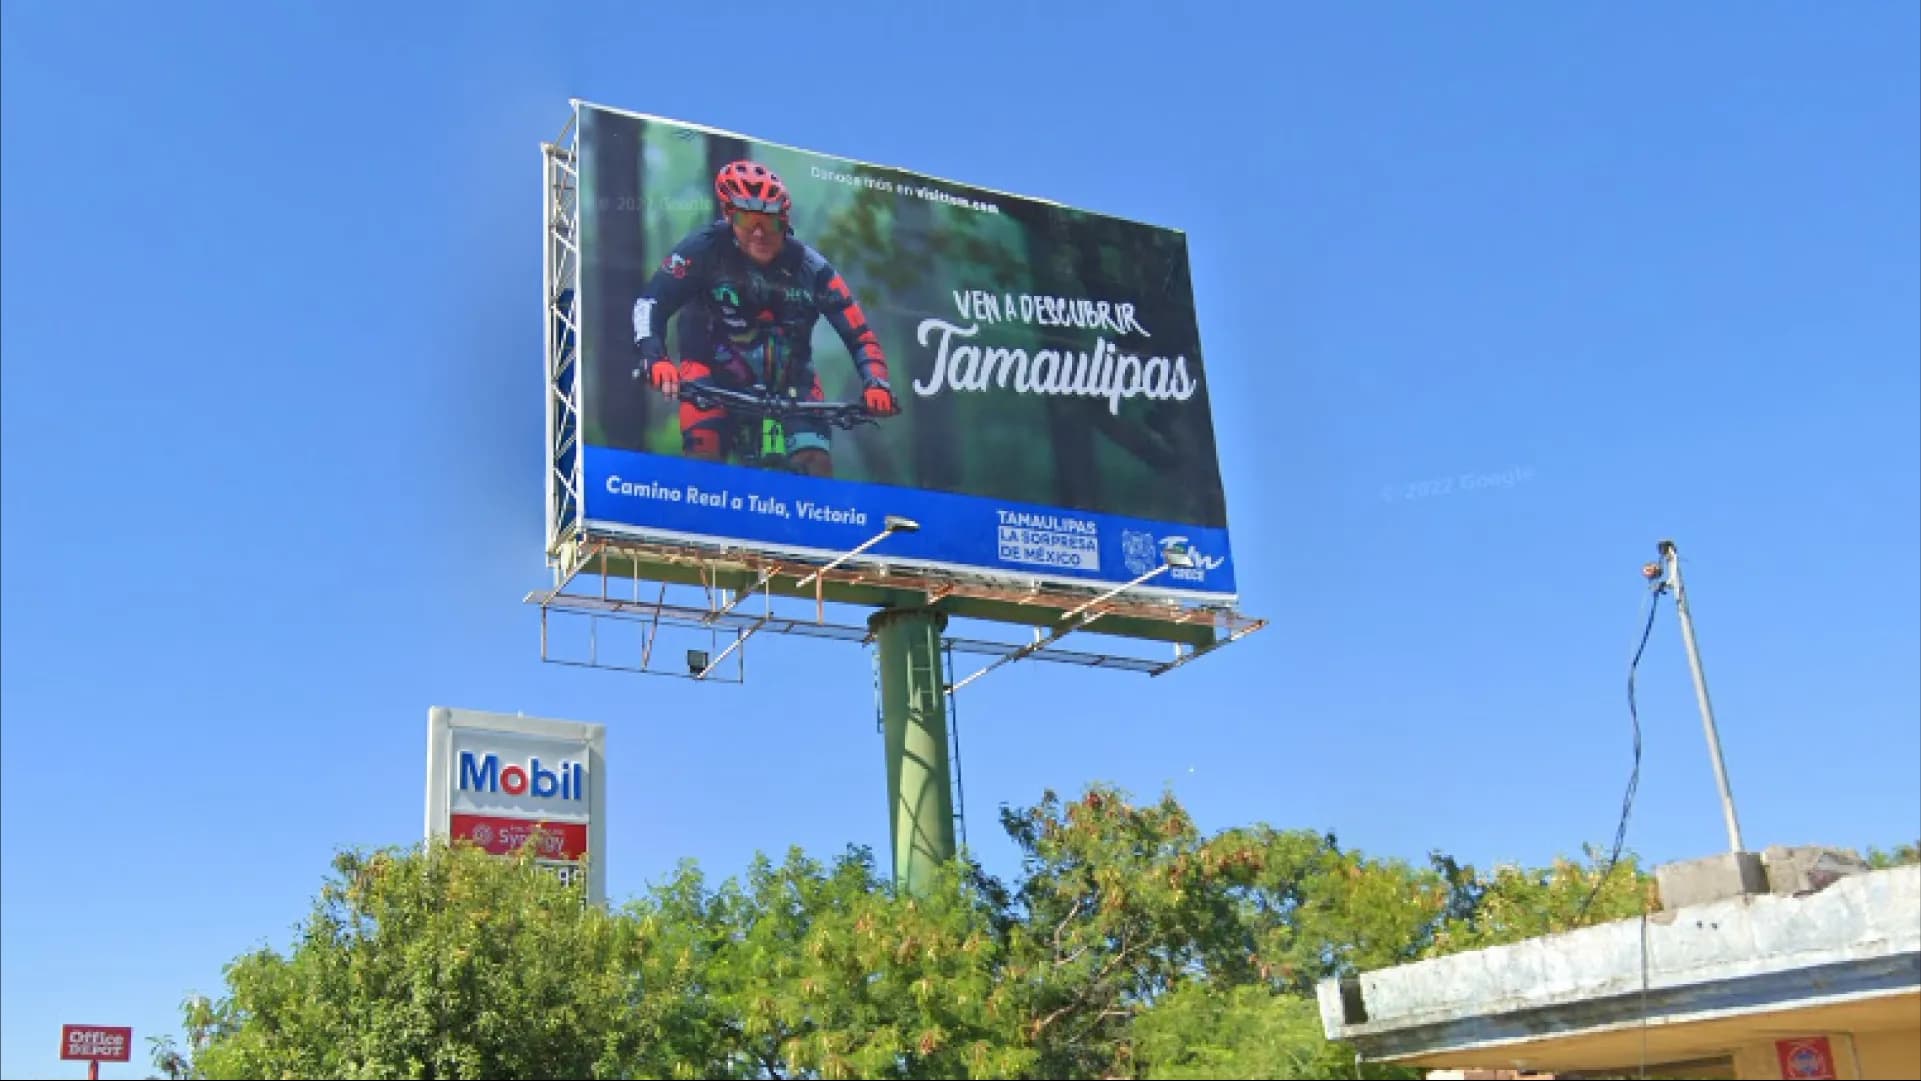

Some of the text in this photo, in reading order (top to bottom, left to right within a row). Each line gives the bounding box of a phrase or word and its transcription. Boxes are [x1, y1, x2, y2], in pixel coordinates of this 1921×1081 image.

[896, 184, 914, 196] en
[952, 289, 1151, 337] VEN A DESCUBRIR
[912, 317, 1197, 416] Tamaulipas
[605, 475, 868, 526] Camino Real a Tula, Victoria
[997, 510, 1097, 535] TAMAULIPAS
[1000, 528, 1097, 554] LA SORPRESA
[1000, 546, 1082, 567] DE MÉXICO
[457, 750, 583, 801] Mobil
[499, 828, 564, 852] Syngy
[68, 1044, 123, 1056] DEPOT
[69, 1031, 124, 1046] Office
